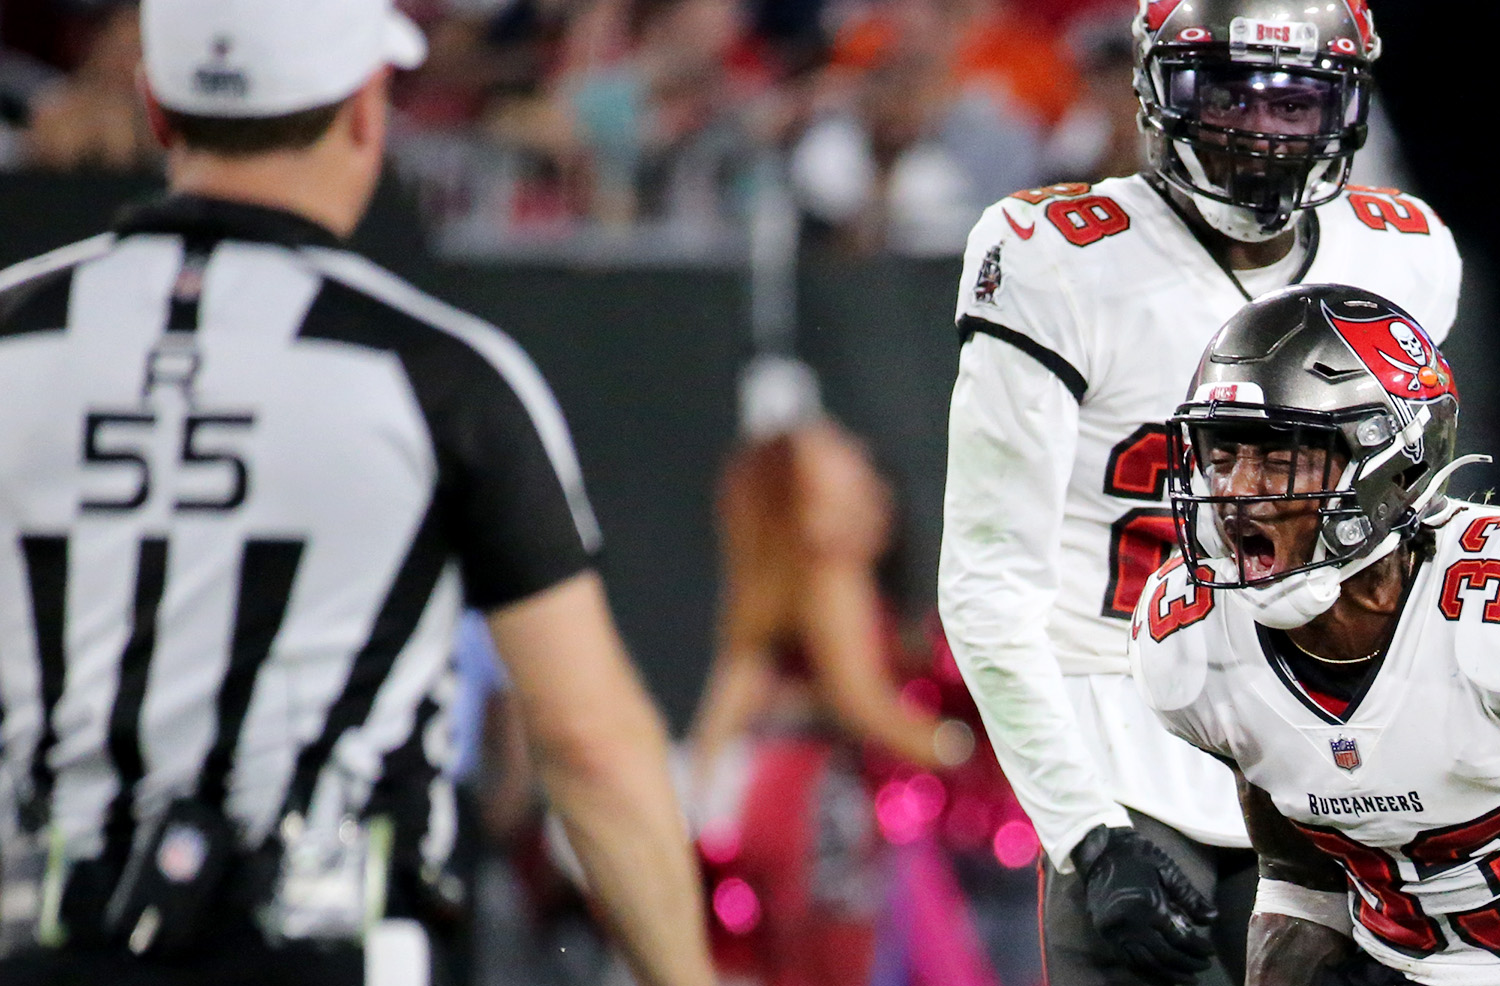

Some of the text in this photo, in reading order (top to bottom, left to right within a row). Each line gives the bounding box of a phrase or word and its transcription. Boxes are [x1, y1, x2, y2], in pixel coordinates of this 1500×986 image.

[1256, 23, 1291, 43] BUCS
[1345, 184, 1431, 236] 2
[140, 334, 203, 415] R
[79, 412, 254, 511] 55
[1148, 554, 1216, 644] 3
[1307, 791, 1425, 818] BUCCANEERS
